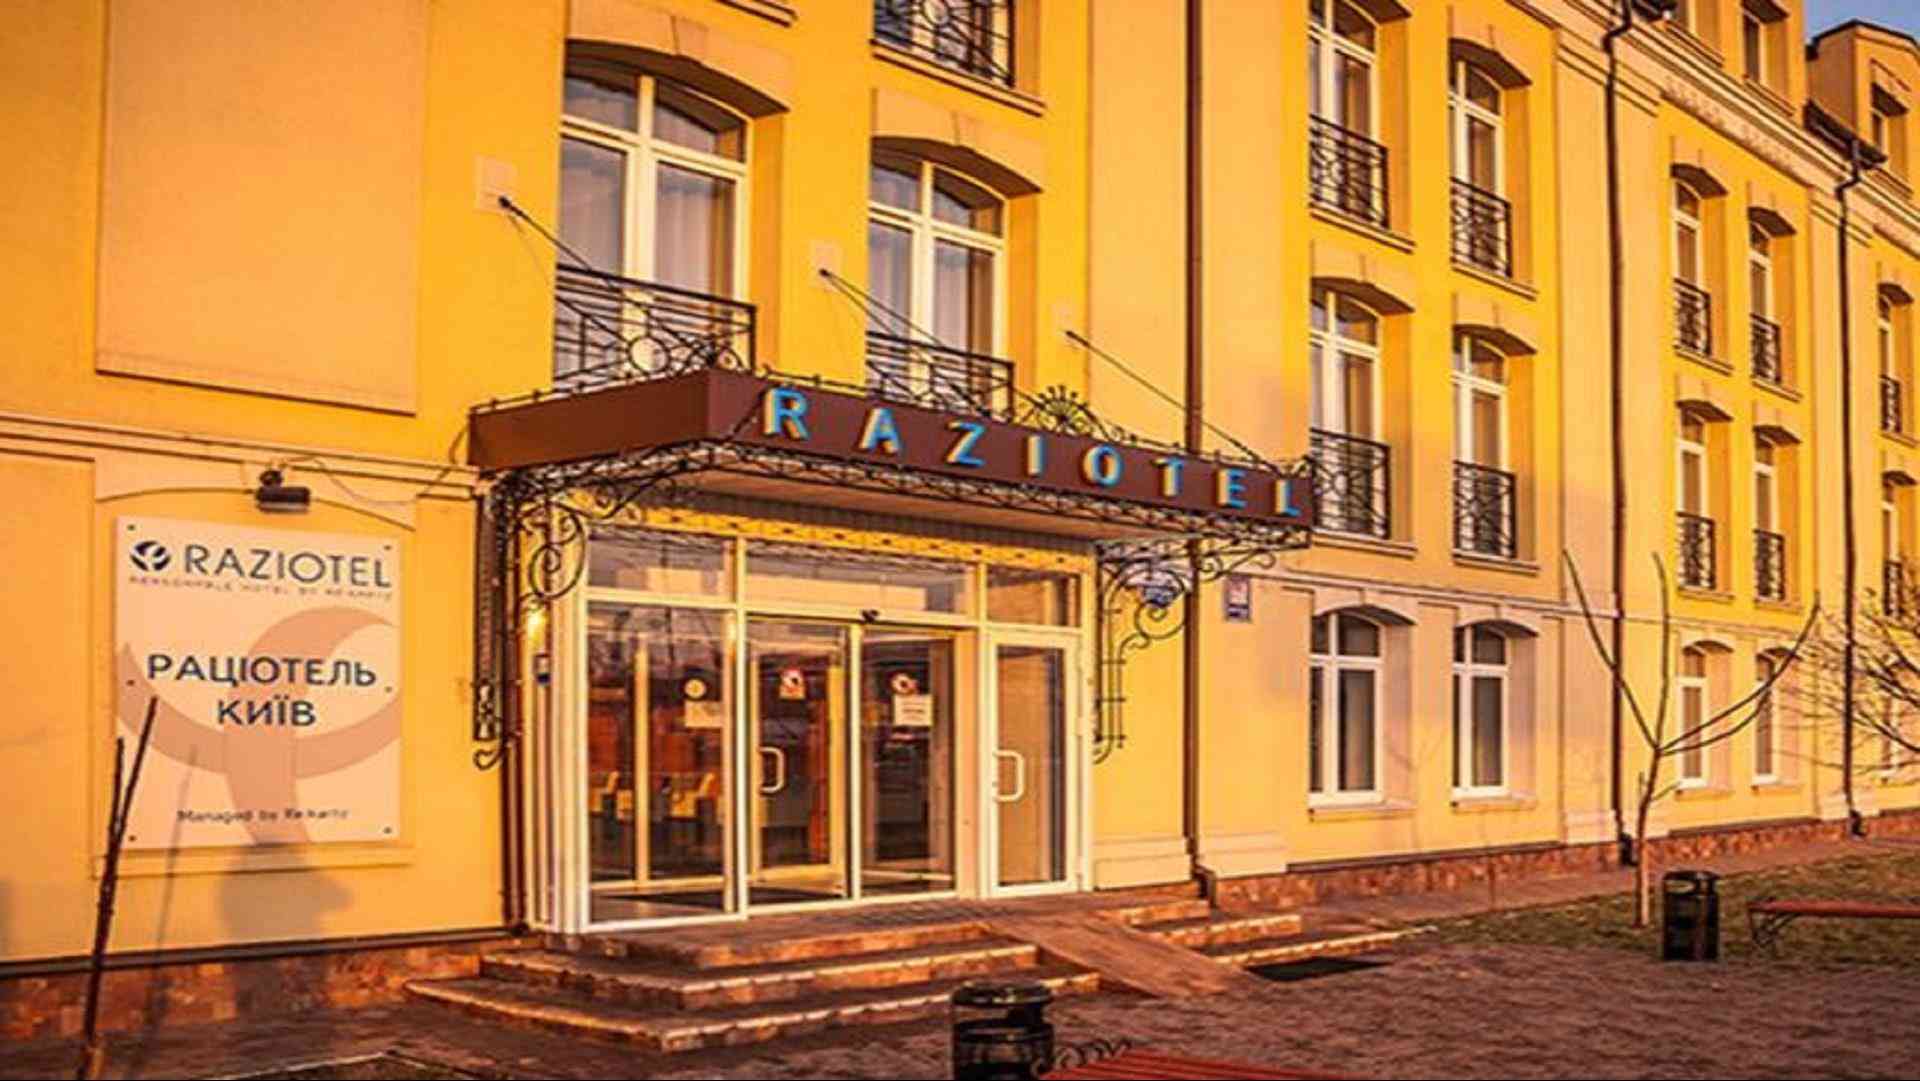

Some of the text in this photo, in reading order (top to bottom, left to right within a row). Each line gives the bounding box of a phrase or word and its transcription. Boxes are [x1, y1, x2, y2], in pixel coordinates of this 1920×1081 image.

[763, 386, 1300, 516] RAZIOTEL
[185, 543, 392, 588] RAZIOTEL
[147, 653, 377, 687] РАЦІОТЕЛЬ
[217, 694, 317, 727] КИЇВ
